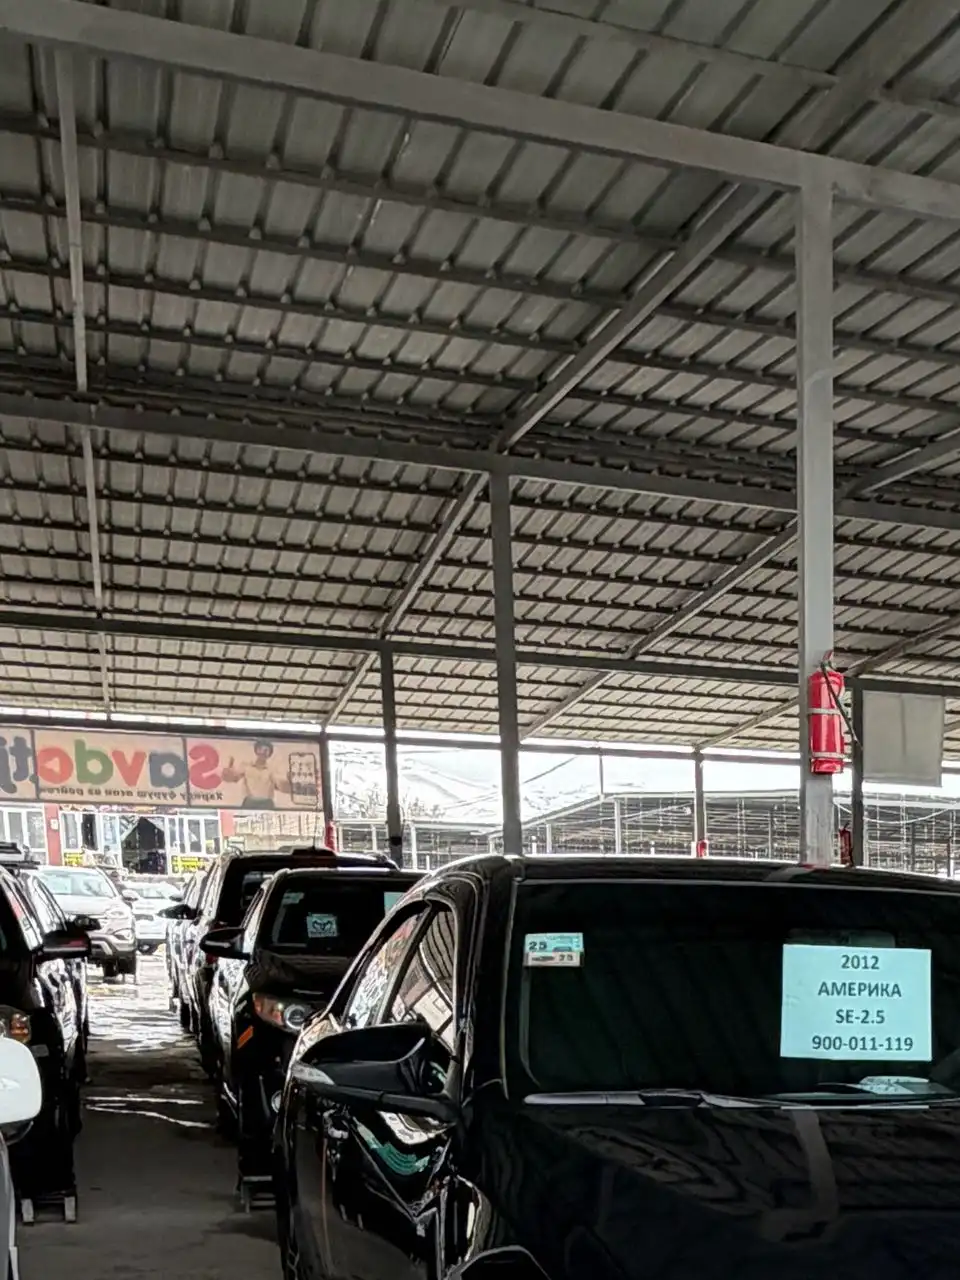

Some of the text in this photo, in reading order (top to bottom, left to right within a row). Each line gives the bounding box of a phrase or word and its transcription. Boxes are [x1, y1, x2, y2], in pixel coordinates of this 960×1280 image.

[841, 954, 880, 970] 2012
[817, 981, 902, 998] АМЕРИКА
[835, 1008, 886, 1025] SE-2.5
[811, 1034, 914, 1052] 900-011-119
